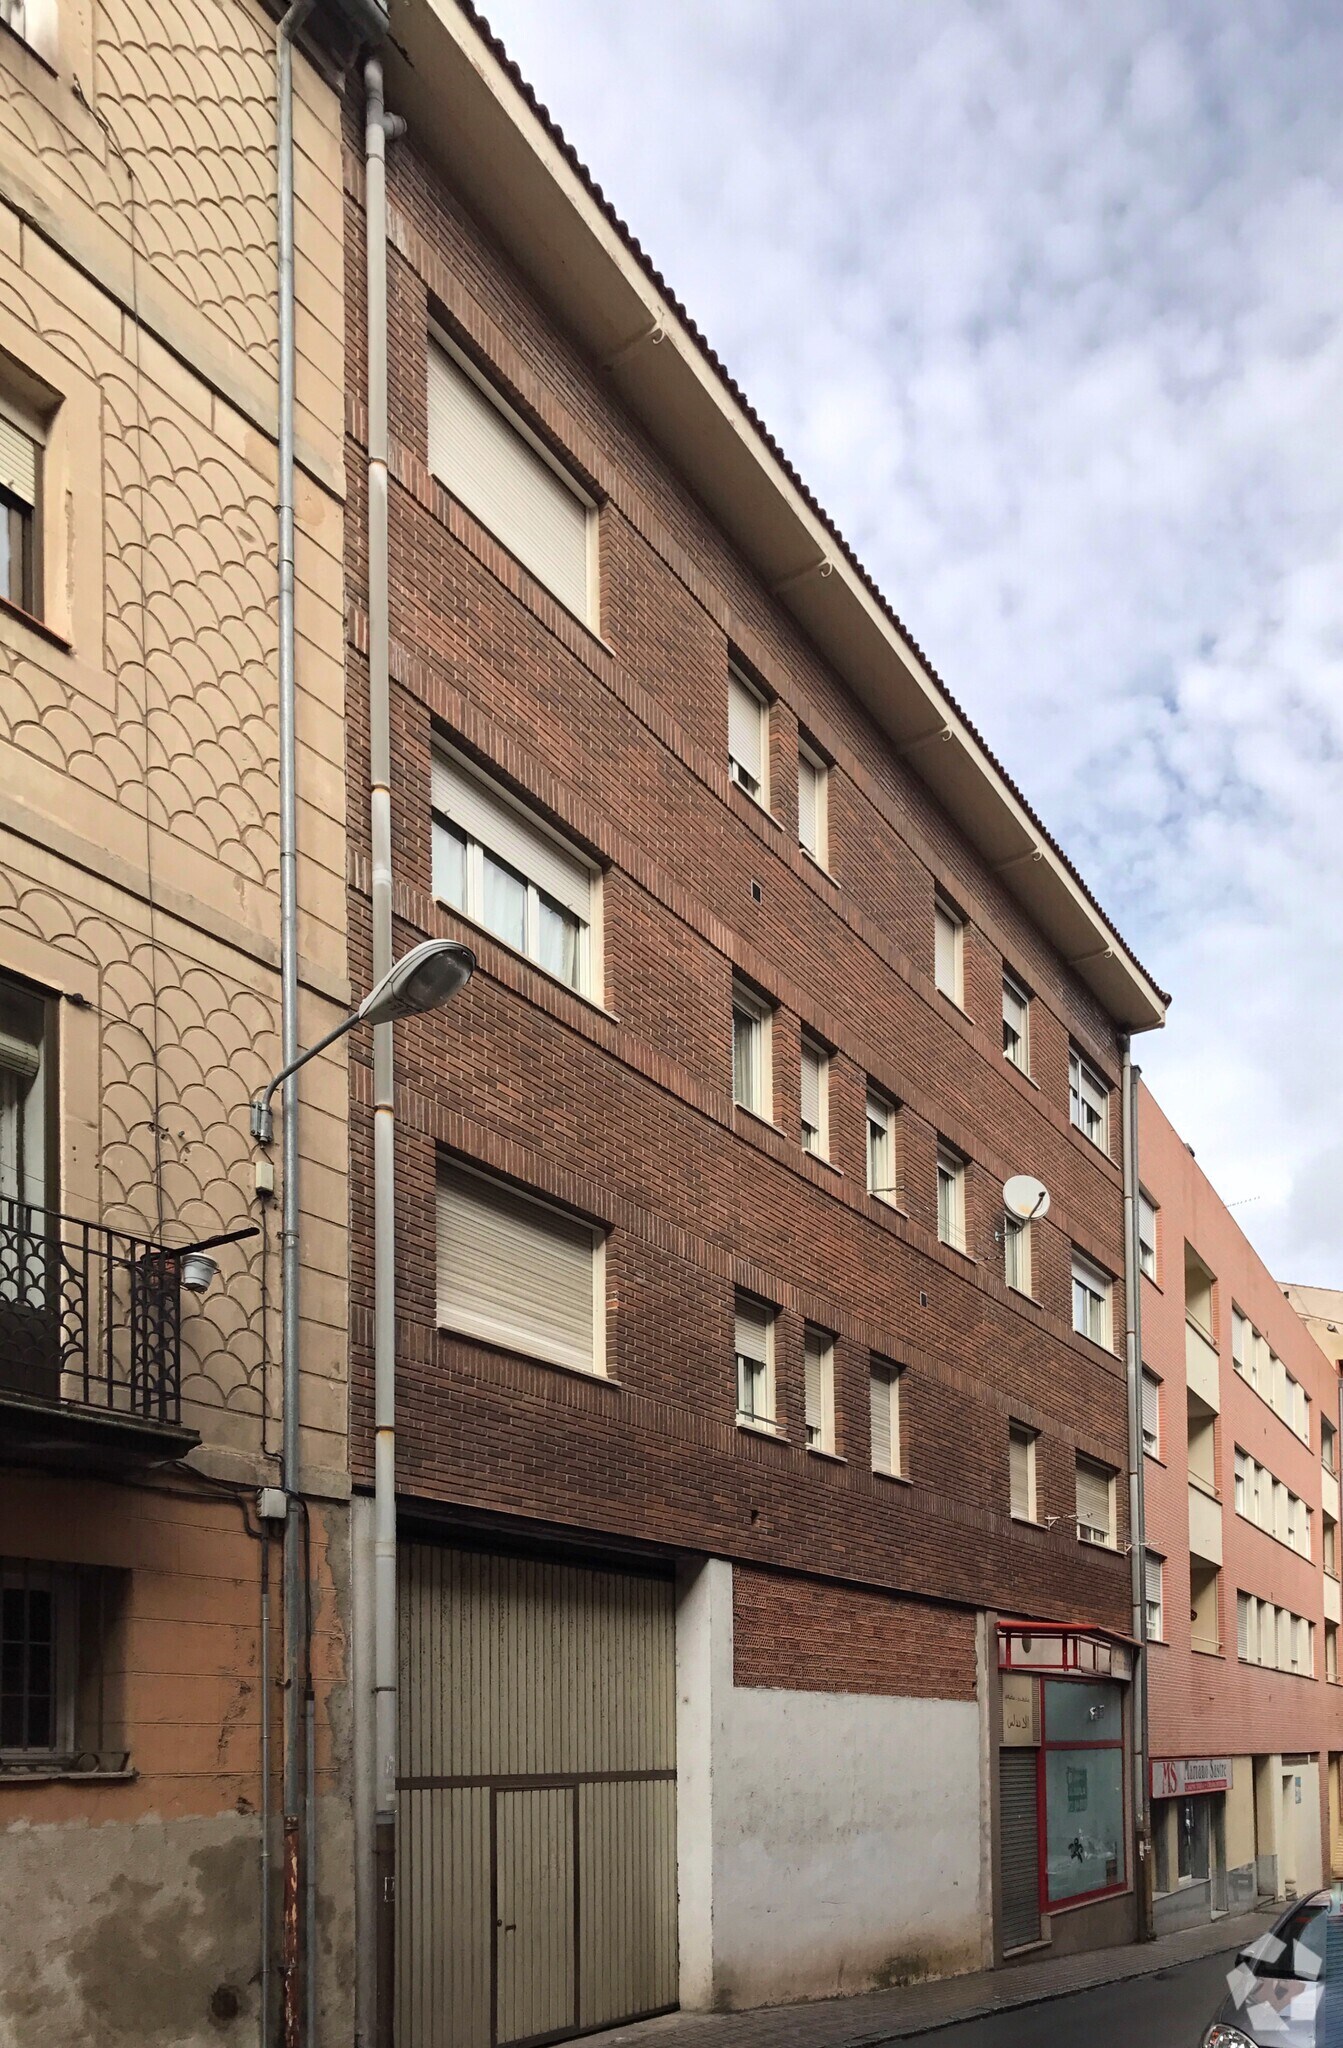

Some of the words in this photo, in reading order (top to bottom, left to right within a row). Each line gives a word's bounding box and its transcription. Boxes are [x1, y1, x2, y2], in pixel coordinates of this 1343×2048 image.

[1162, 1761, 1178, 1794] MS
[1184, 1760, 1208, 1780] Mariano
[1210, 1759, 1227, 1778] Sastre
